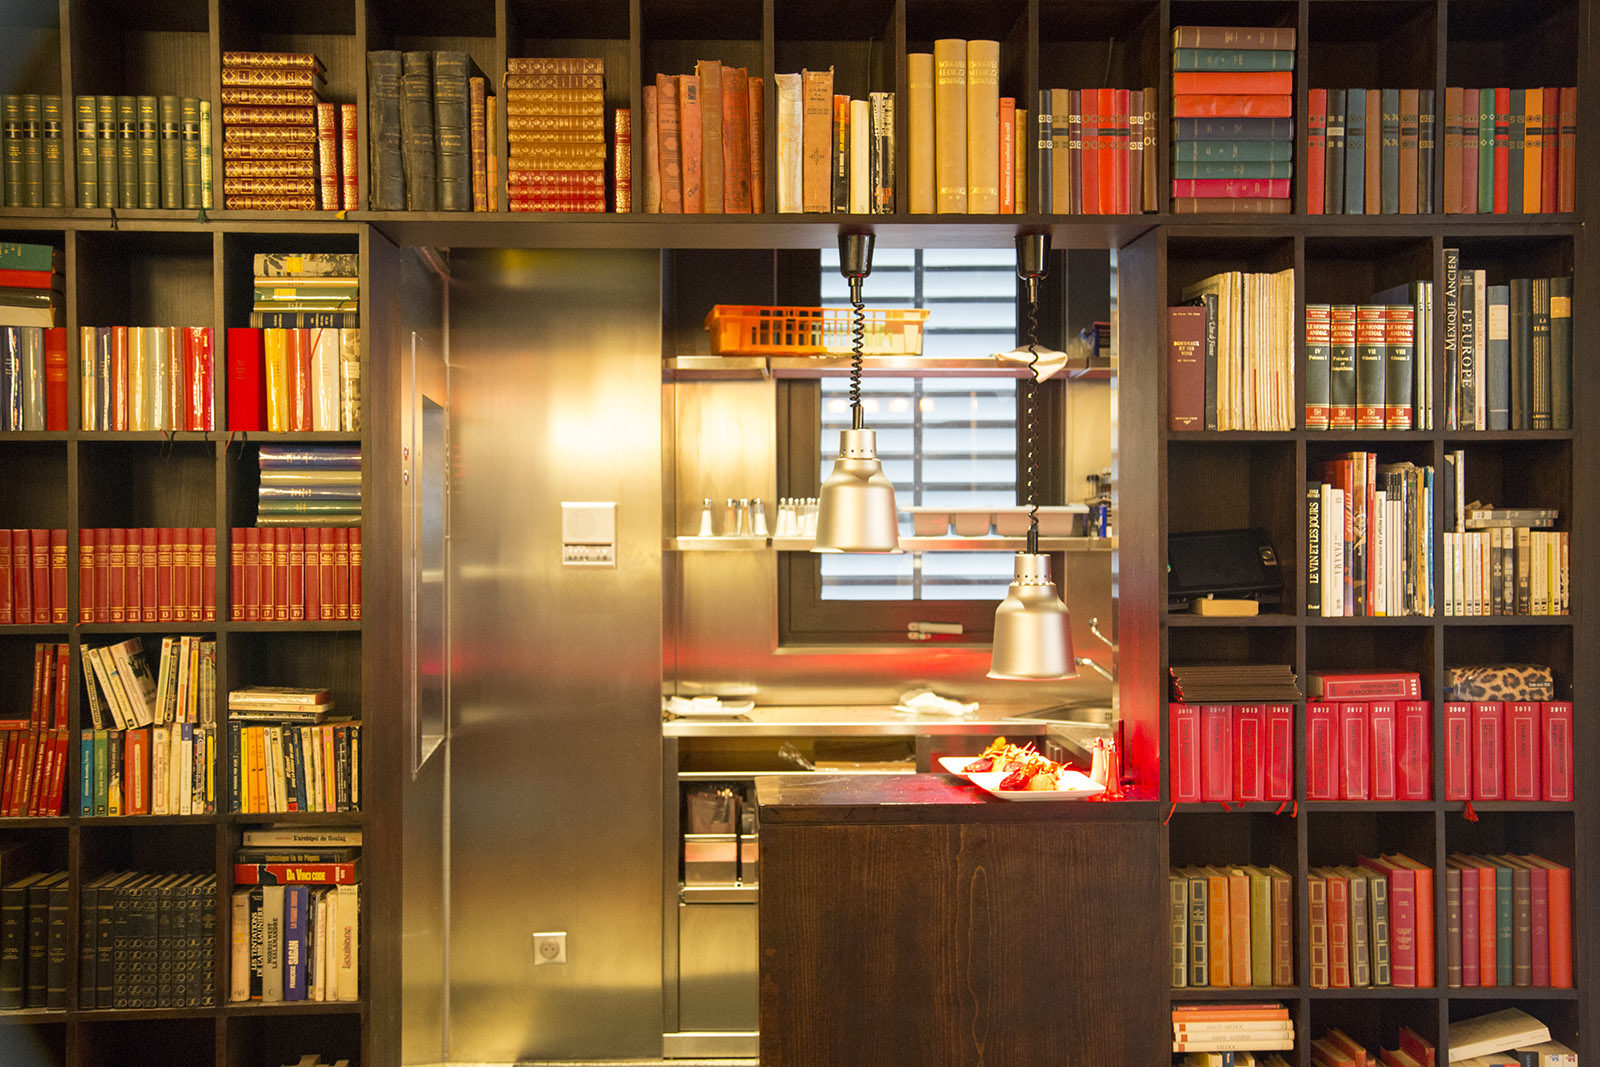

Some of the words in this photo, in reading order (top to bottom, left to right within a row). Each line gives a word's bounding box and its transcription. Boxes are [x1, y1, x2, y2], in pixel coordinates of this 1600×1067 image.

[1462, 310, 1472, 388] L'EUROPE
[1309, 502, 1319, 529] JOURS
[1309, 529, 1319, 543] LES
[1309, 545, 1319, 555] ET
[1334, 542, 1343, 575] PANAMA
[1309, 555, 1319, 573] VIN
[1309, 574, 1319, 584] LE
[288, 940, 298, 965] SAGAN
